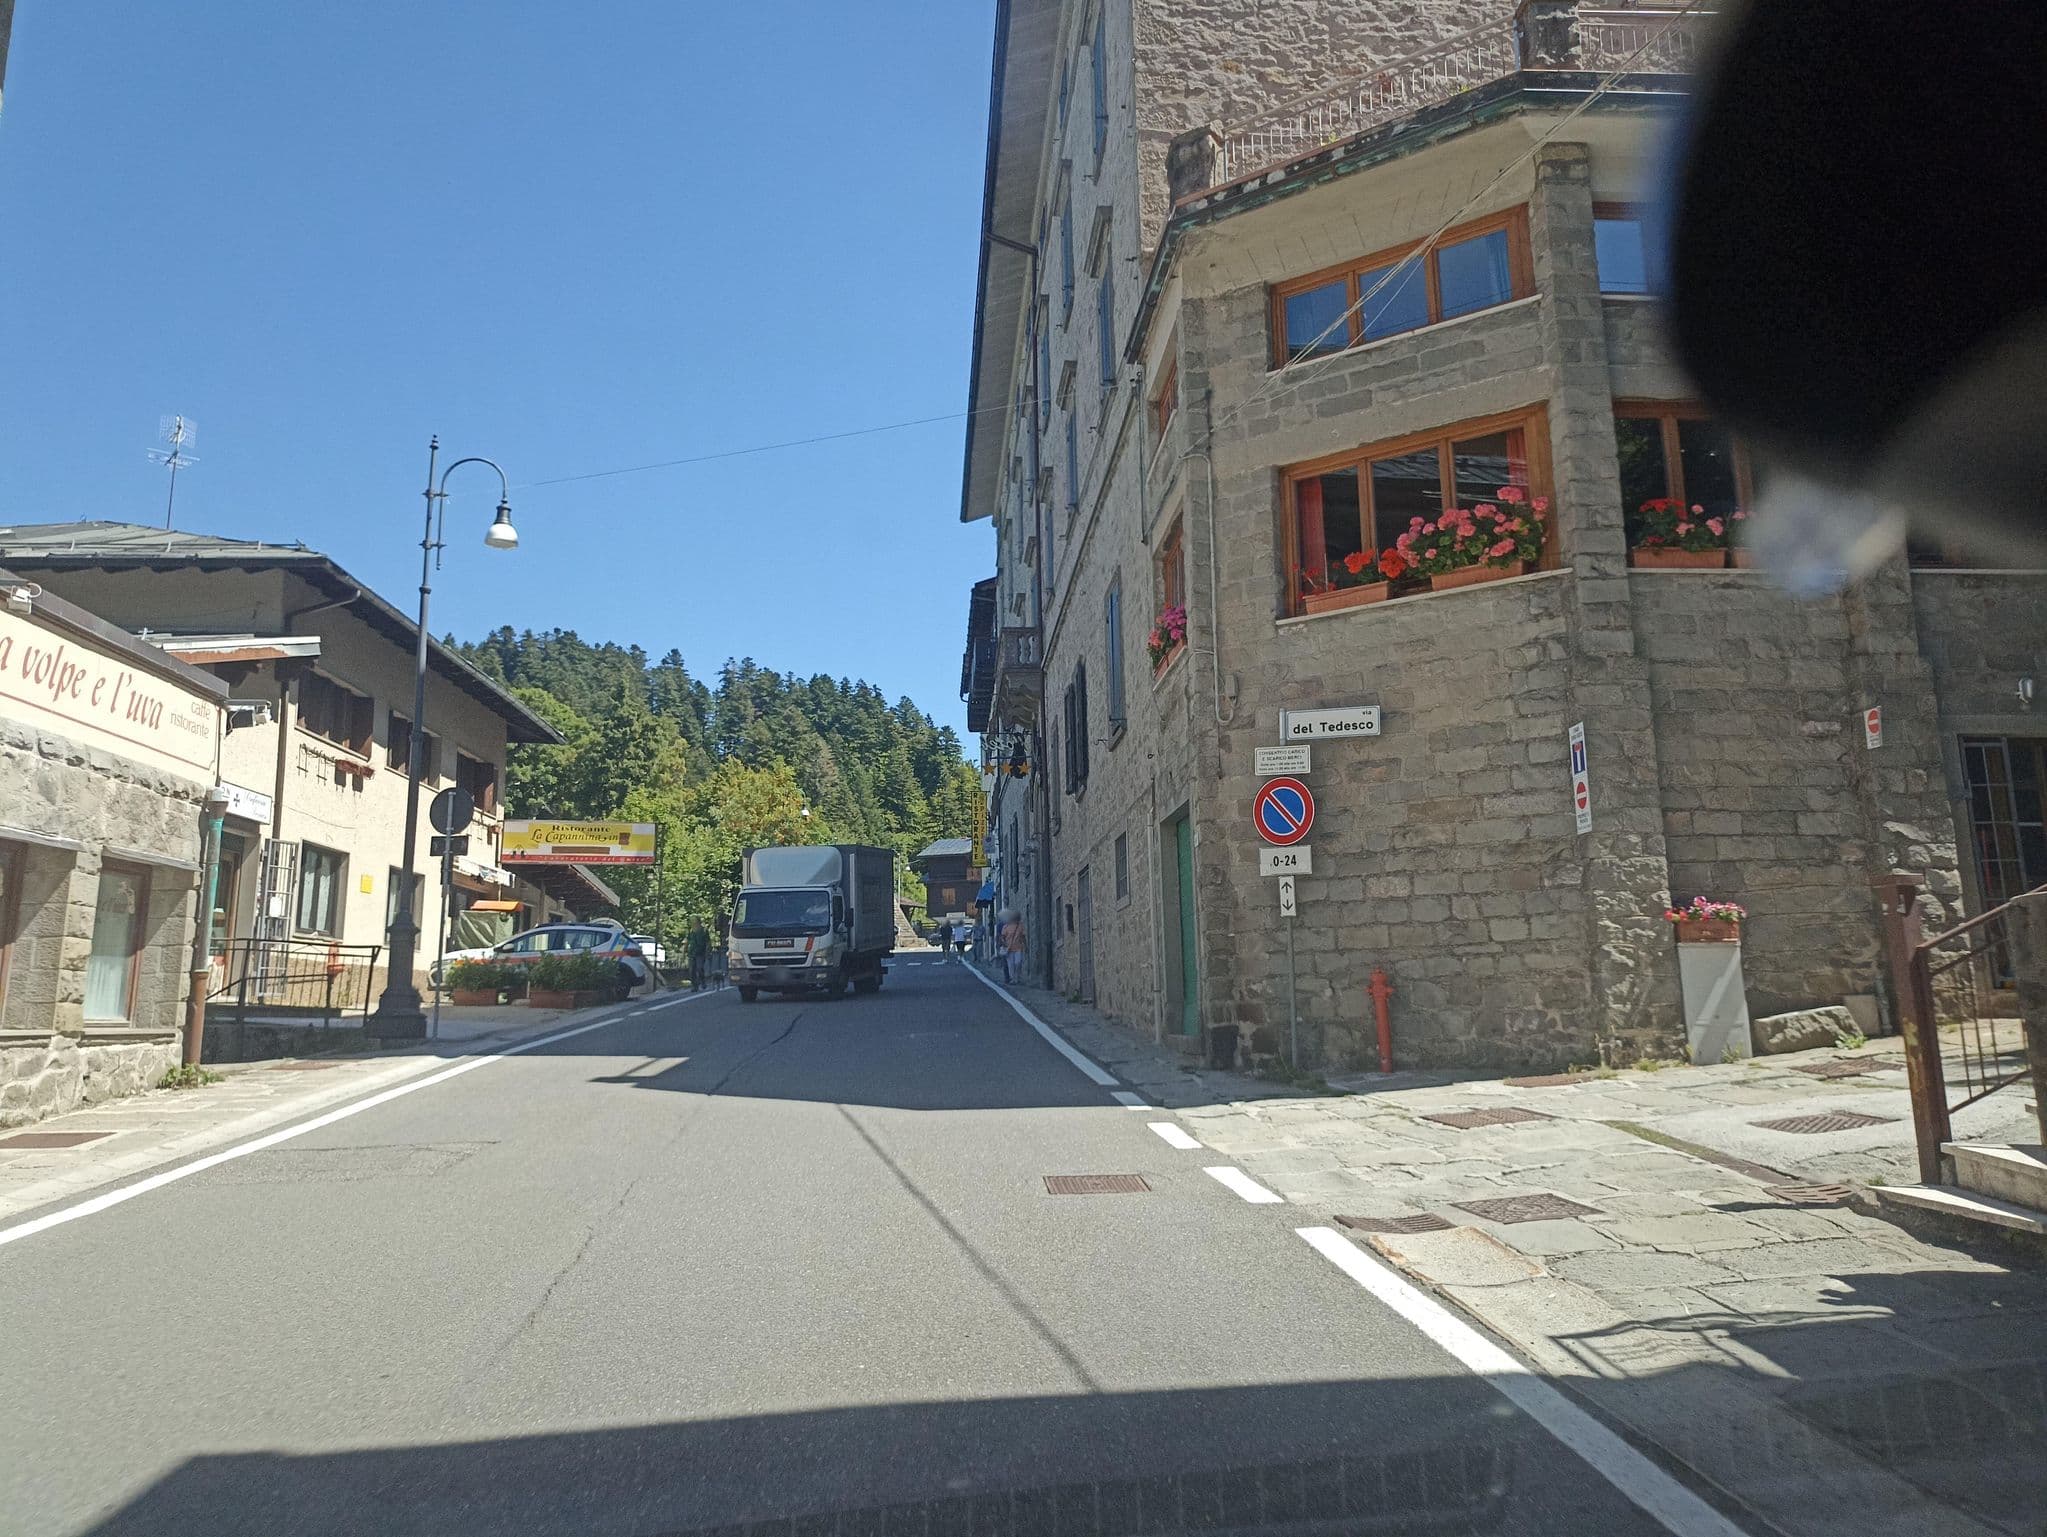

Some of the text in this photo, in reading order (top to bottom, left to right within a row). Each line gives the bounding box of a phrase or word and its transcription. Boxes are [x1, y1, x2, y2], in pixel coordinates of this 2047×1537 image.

[22, 645, 87, 702] volpe
[91, 677, 107, 707] e
[110, 672, 164, 730] l'uva
[170, 712, 210, 739] ristorante
[1293, 720, 1374, 735] del Tedesco
[531, 828, 543, 843] La
[545, 831, 606, 844] Capannina
[1273, 854, 1297, 867] 0-24
